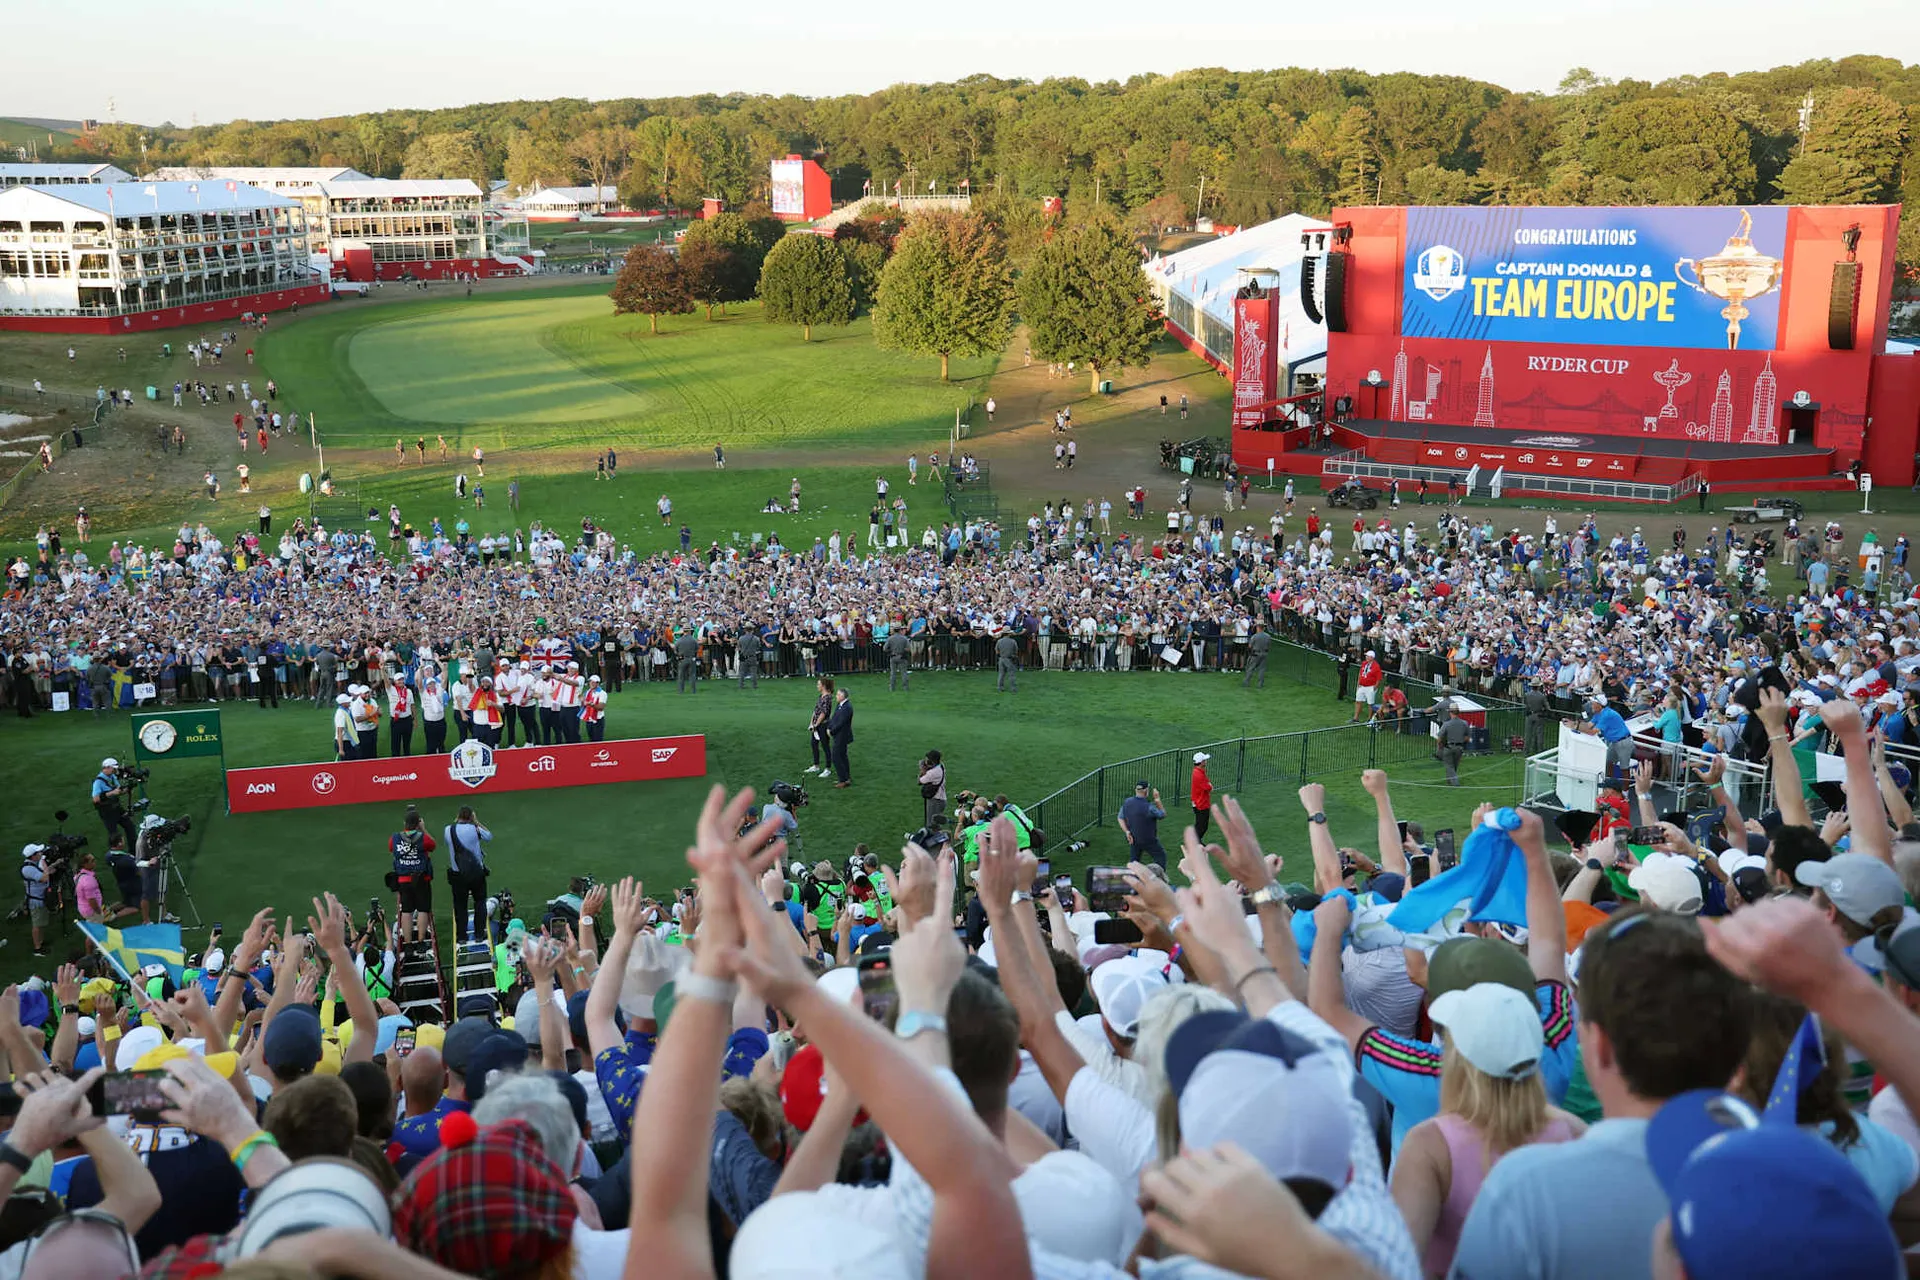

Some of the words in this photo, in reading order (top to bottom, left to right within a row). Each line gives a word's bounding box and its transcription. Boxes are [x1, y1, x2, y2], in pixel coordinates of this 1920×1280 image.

[1514, 228, 1637, 246] CONGRATULATIONS
[1496, 262, 1563, 277] CAPTAIN
[1567, 263, 1636, 277] DONALD
[1640, 264, 1652, 277] &
[1470, 277, 1548, 318] TEAM
[1555, 278, 1677, 322] EUROPE
[1528, 356, 1588, 373] RYDER
[1589, 358, 1629, 375] CUP
[1427, 448, 1443, 456] AON
[1518, 453, 1534, 464] citi
[186, 734, 218, 743] ROLEX
[653, 750, 672, 760] SAP
[528, 755, 555, 772] citi
[372, 773, 410, 785] Capgemini
[246, 783, 276, 795] AON
